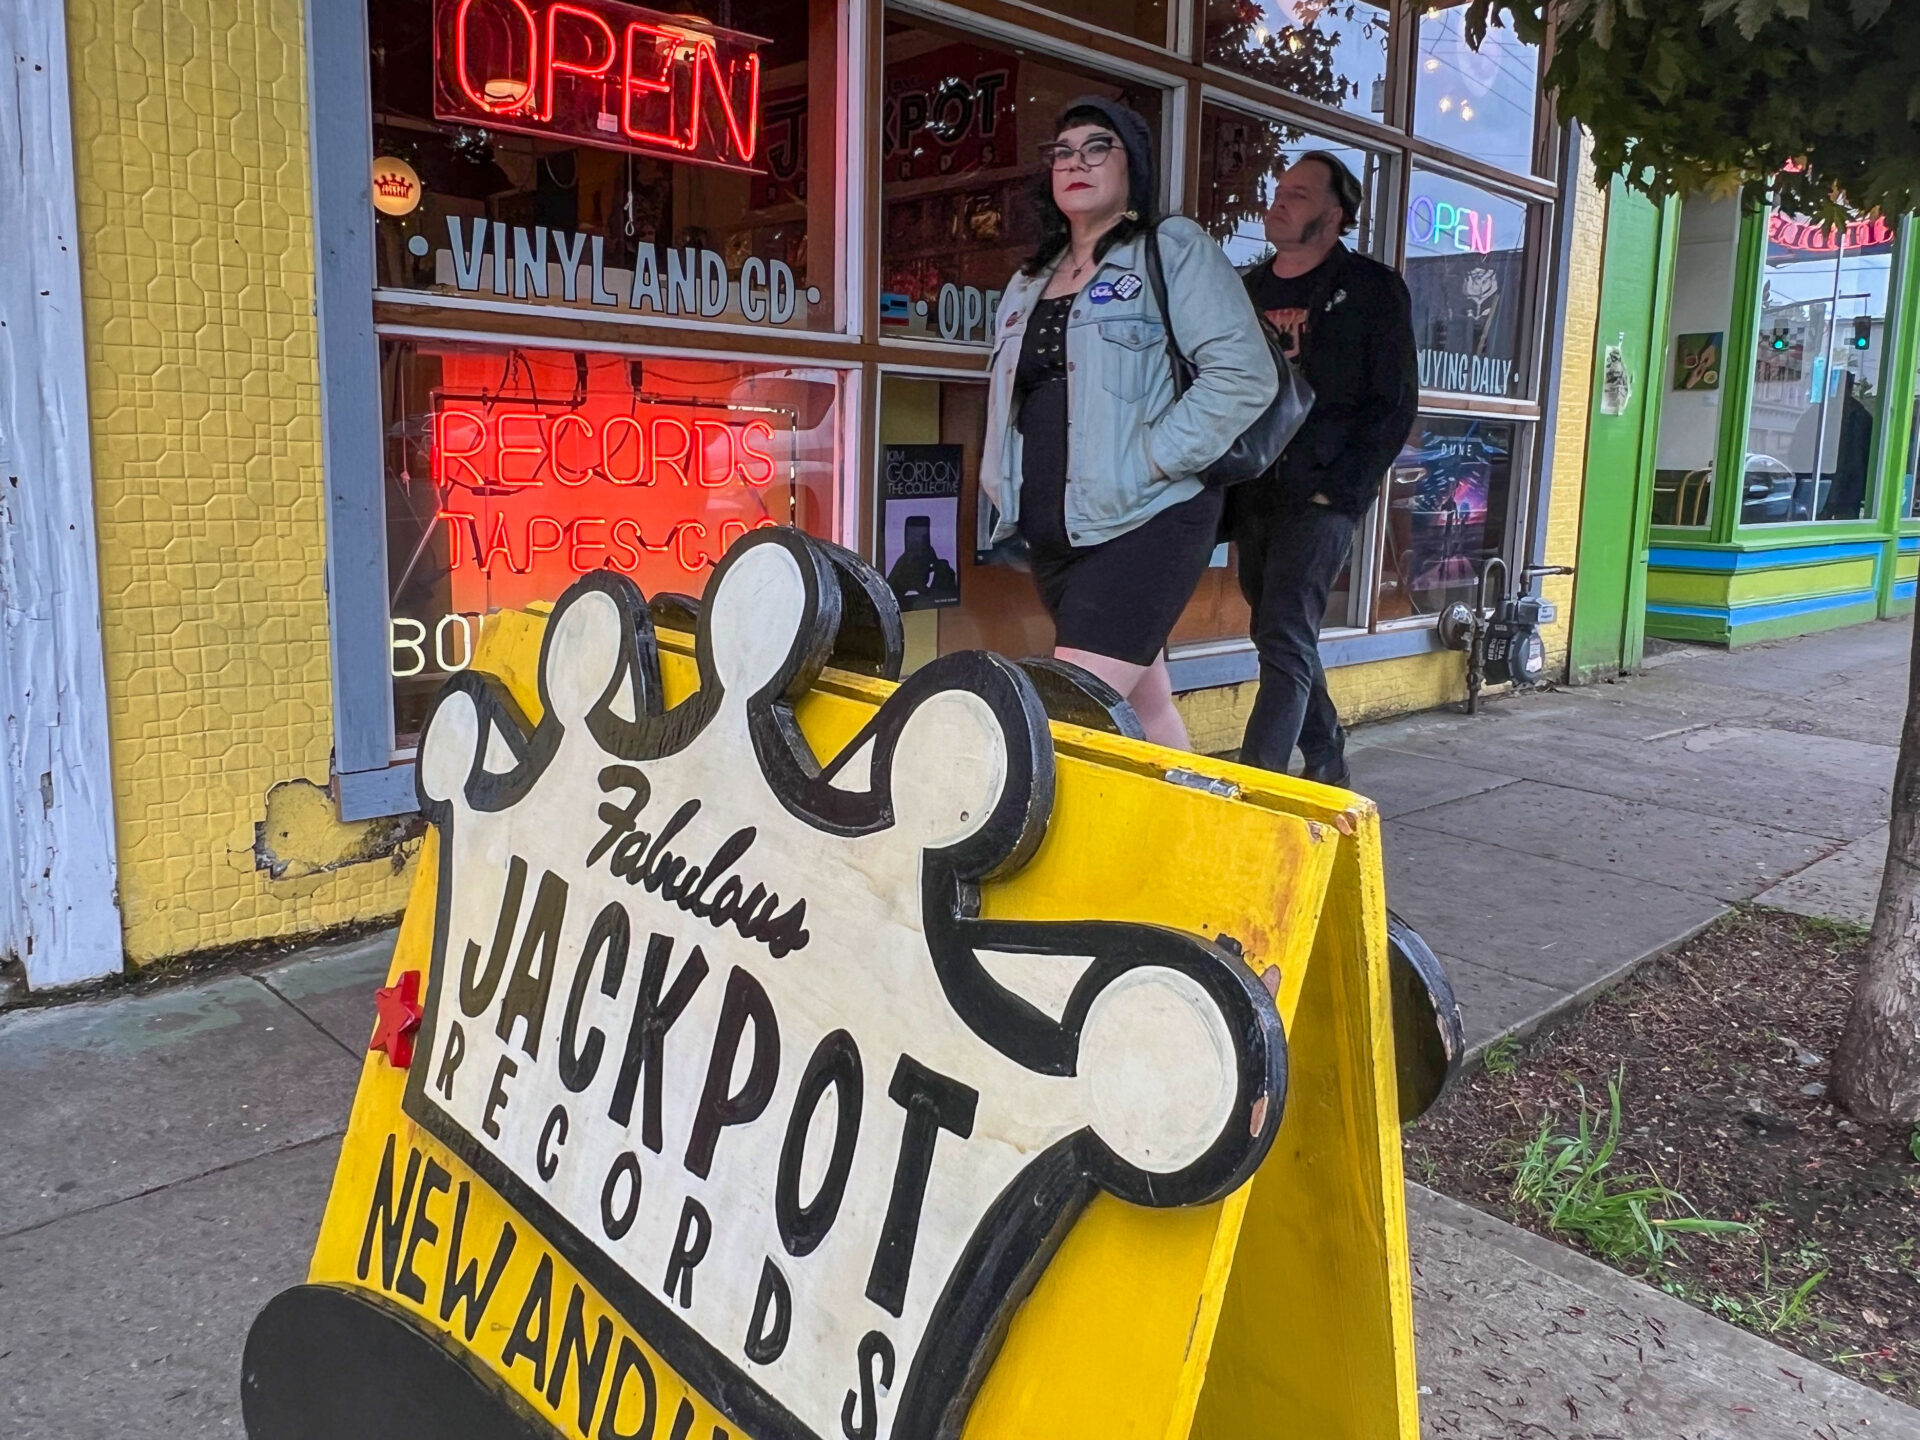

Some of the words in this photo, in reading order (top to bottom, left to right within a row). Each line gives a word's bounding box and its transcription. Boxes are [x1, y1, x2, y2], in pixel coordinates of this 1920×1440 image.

[457, 0, 760, 162] OPEN
[1408, 196, 1493, 254] OPEN
[446, 215, 618, 307] VINYL
[630, 241, 728, 318] AND
[740, 256, 795, 325] CD
[1418, 349, 1468, 392] UYING
[1471, 355, 1512, 395] DAILY
[438, 410, 776, 488] RECORDS
[887, 451, 904, 462] KIM
[887, 461, 960, 482] GORDON
[1441, 443, 1472, 456] DUNE
[888, 483, 904, 495] THE
[905, 481, 959, 495] COLLECTIVE
[390, 614, 483, 676] BO
[586, 764, 810, 958] Fabulous
[460, 855, 979, 1317] JACKPOT
[436, 1020, 896, 1440] RECORDS
[357, 1134, 517, 1342] NEW
[501, 1252, 657, 1440] AND
